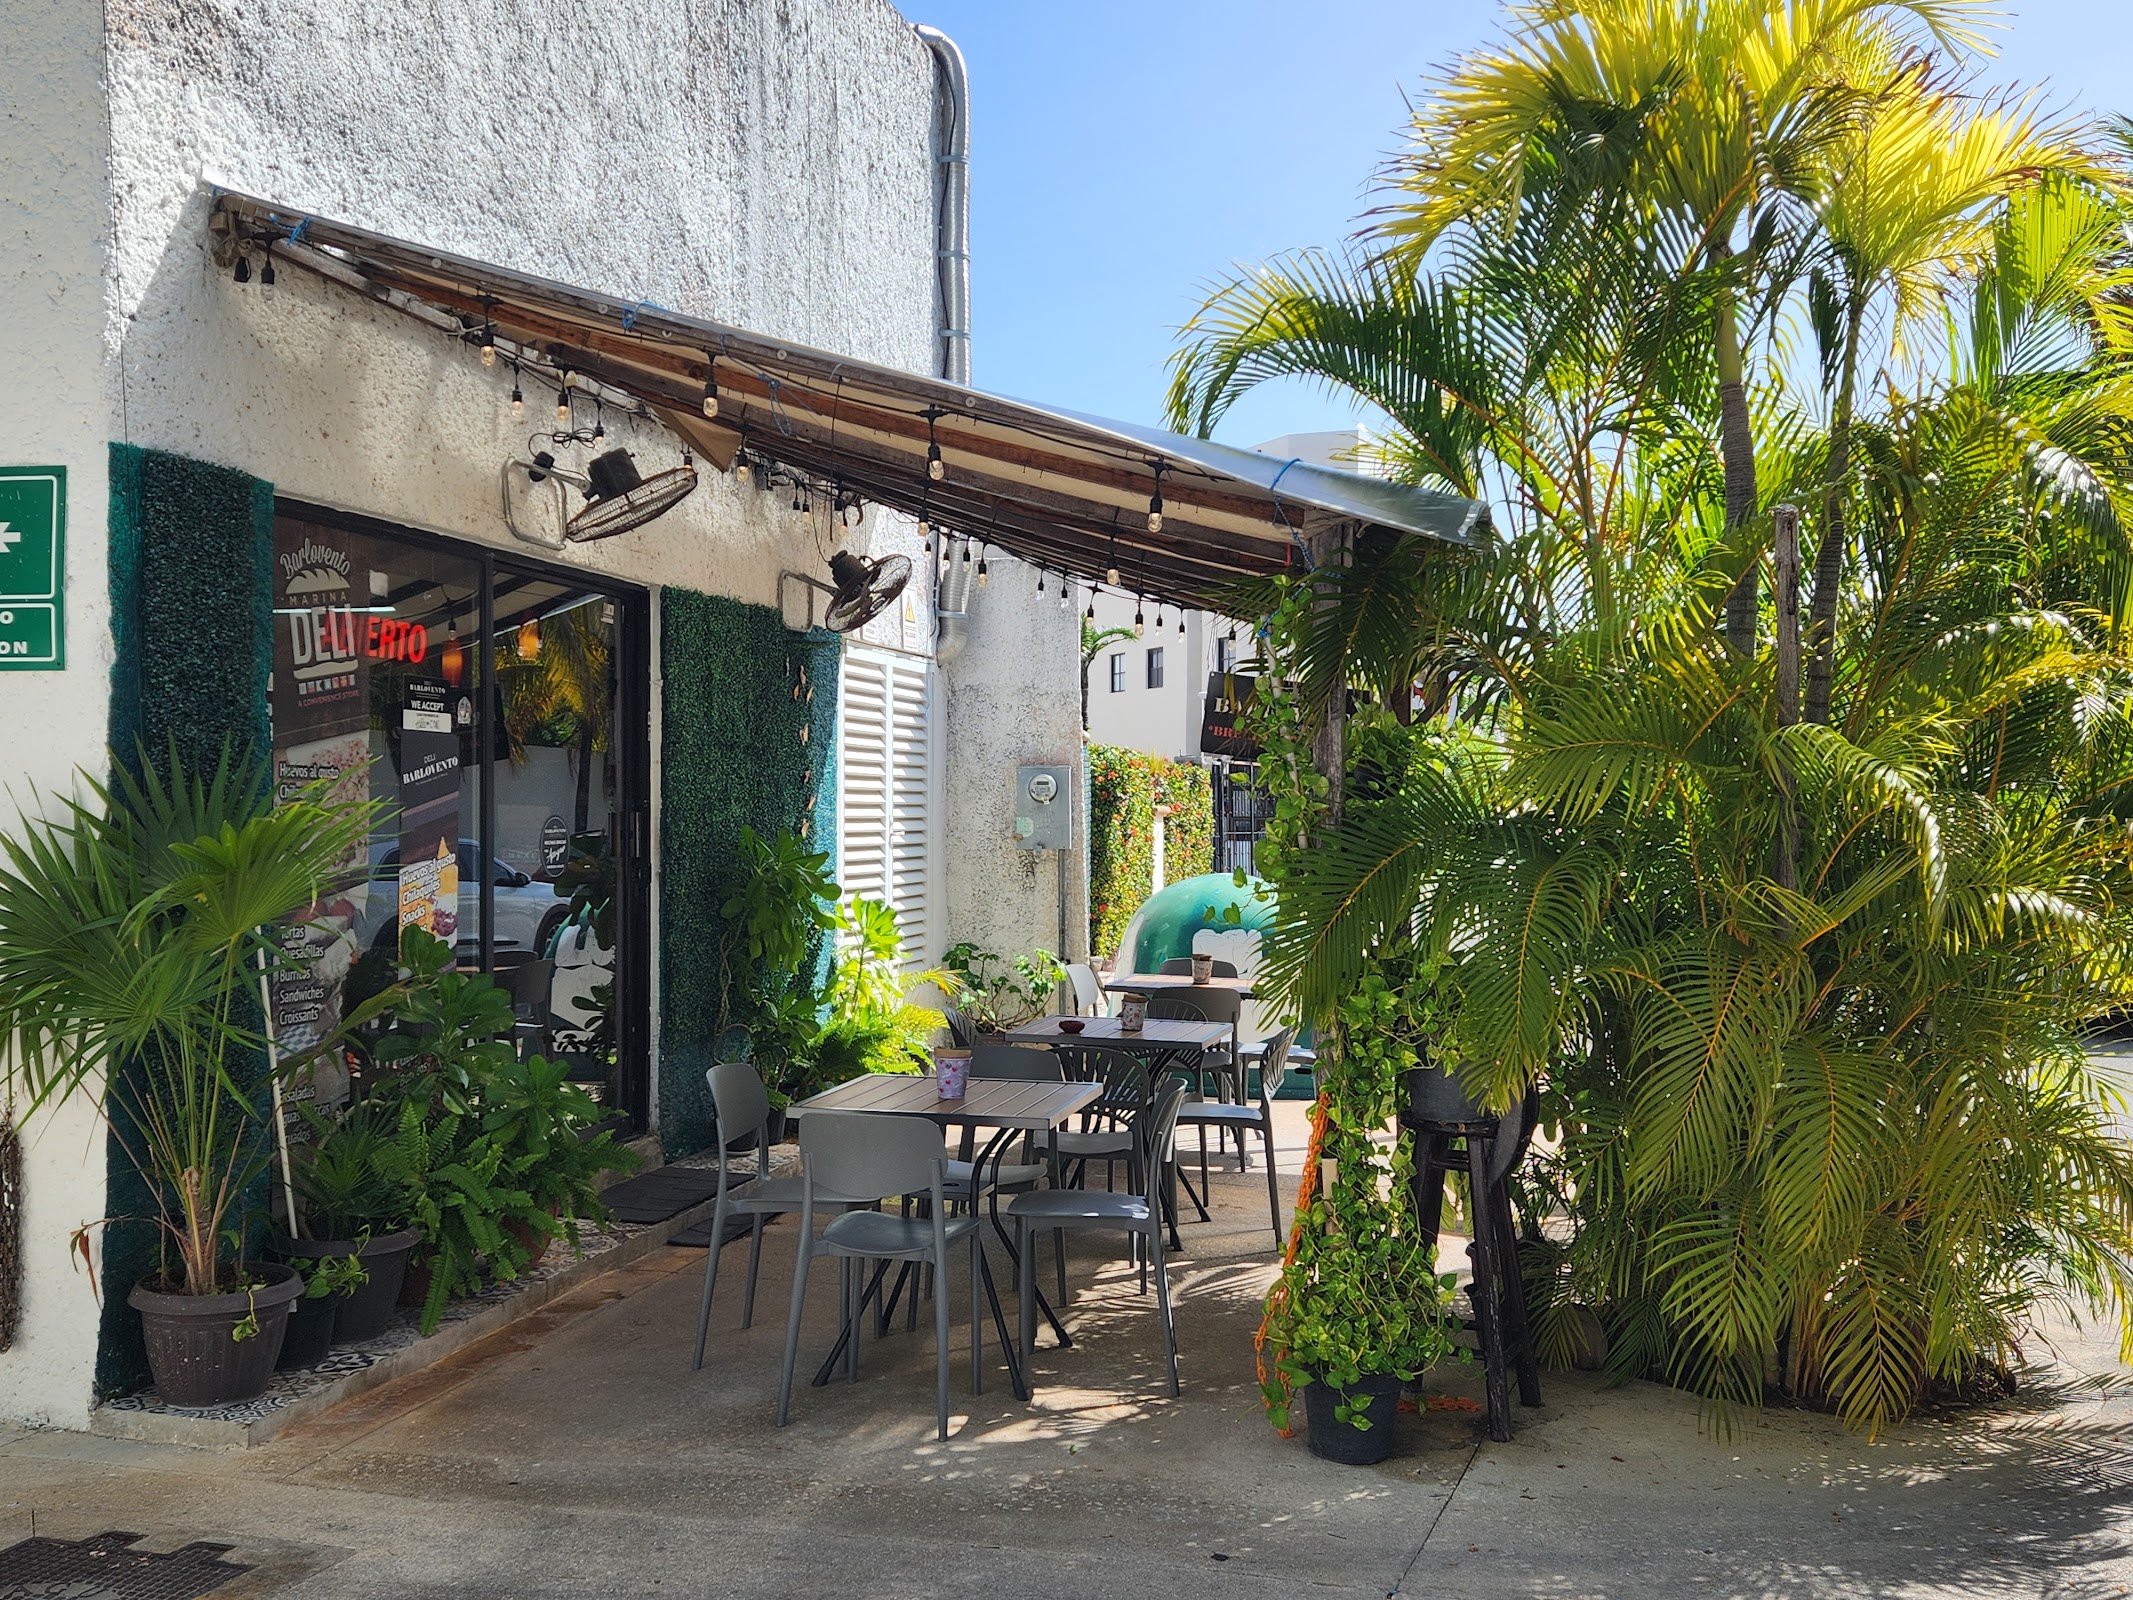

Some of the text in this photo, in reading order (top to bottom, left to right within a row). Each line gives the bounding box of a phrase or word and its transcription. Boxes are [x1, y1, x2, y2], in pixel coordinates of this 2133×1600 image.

[280, 537, 350, 579] Barlovento
[289, 591, 347, 606] MARINA
[289, 603, 355, 665] DELI
[409, 684, 446, 694] BARLOVENTO
[411, 700, 445, 712] WE ACCEPT
[423, 753, 436, 764] DELI
[309, 764, 317, 778] al
[402, 756, 459, 785] BARLOVENTO
[402, 852, 456, 886] Huevos al gusto
[402, 878, 440, 905] Chilaquiles
[402, 905, 426, 926] Snacks
[280, 986, 324, 1004] Sandwiches
[280, 1008, 319, 1025] Croissants
